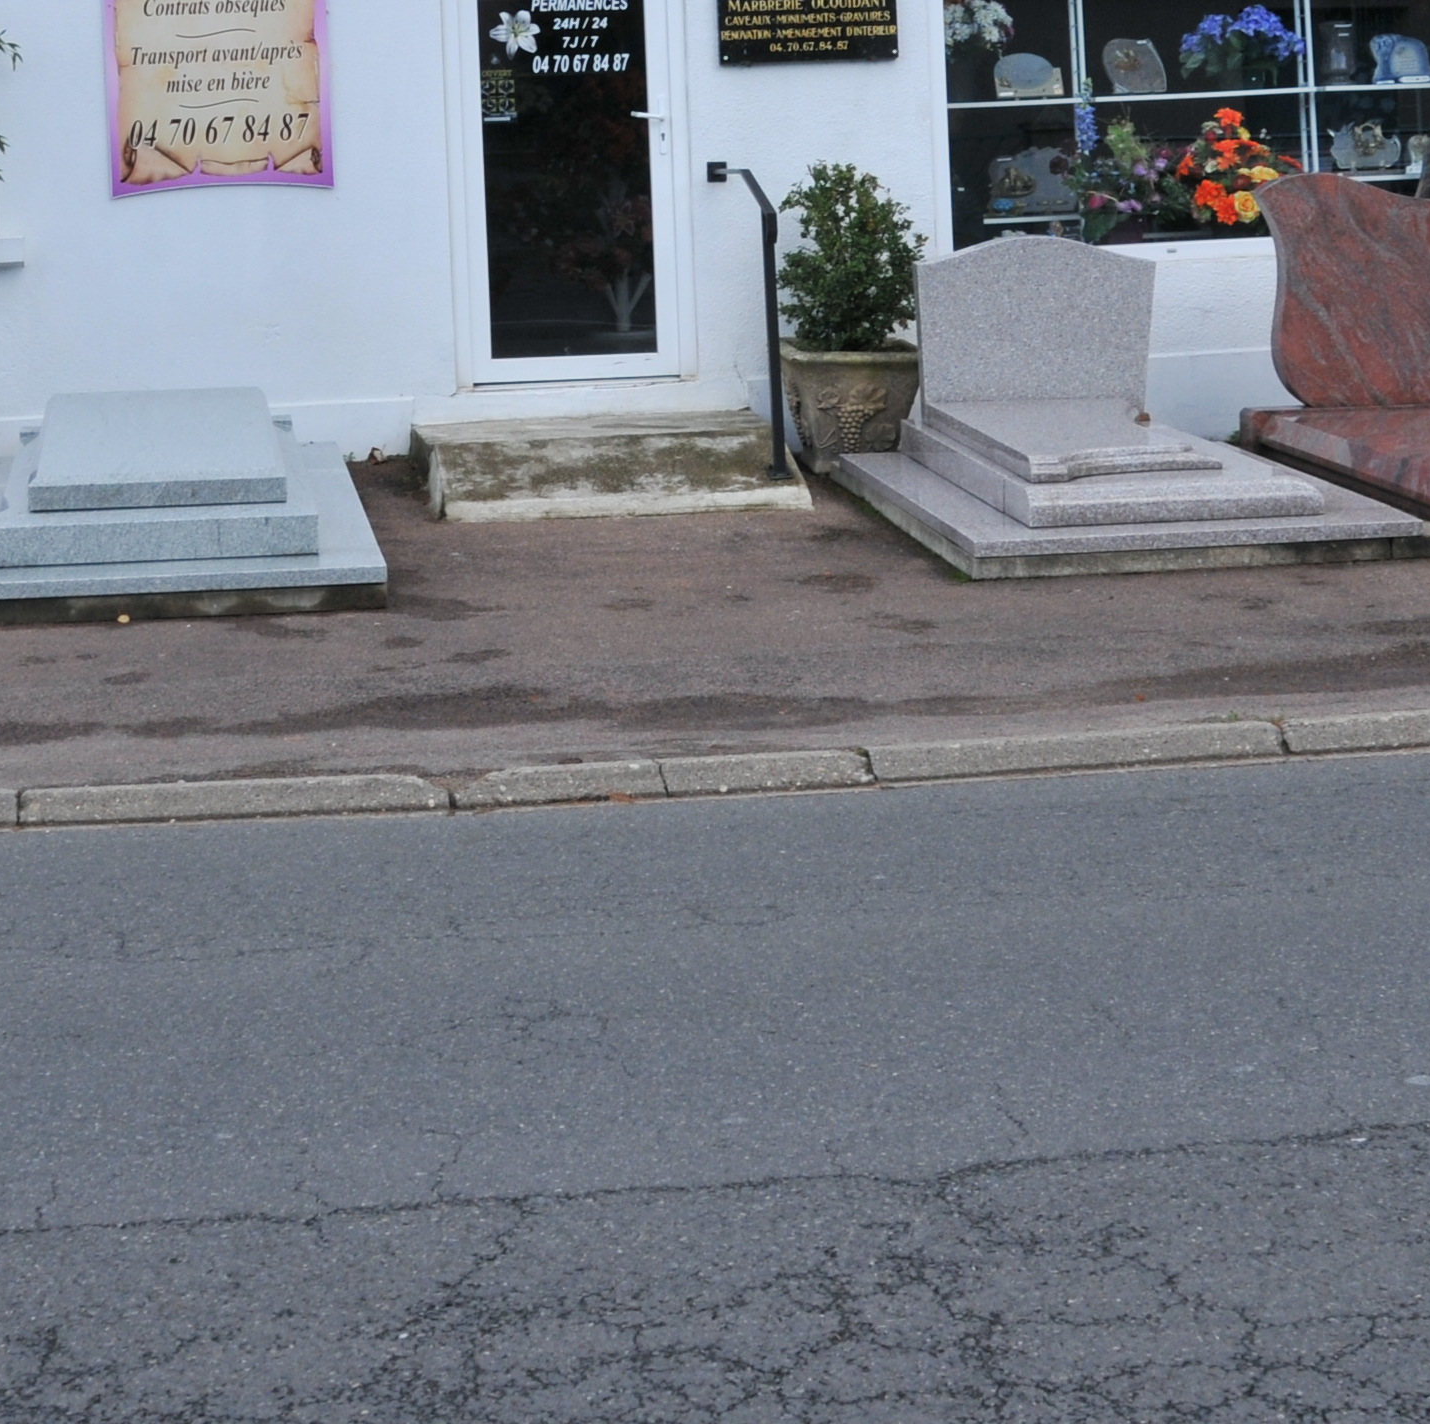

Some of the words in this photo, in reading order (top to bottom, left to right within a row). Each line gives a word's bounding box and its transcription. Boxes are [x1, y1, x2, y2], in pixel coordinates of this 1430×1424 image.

[552, 18, 580, 30] 24H
[592, 17, 608, 29] 24
[562, 36, 578, 48] 7J
[590, 36, 599, 48] 7
[131, 47, 207, 69] Transport
[211, 42, 303, 68] avant/après
[532, 55, 549, 73] 04
[553, 55, 569, 73] 70
[573, 54, 589, 72] 67
[593, 54, 609, 72] 84
[613, 53, 630, 71] 87
[166, 74, 203, 93] mise
[207, 77, 225, 92] en
[230, 72, 270, 90] bière
[129, 119, 158, 150] 04
[168, 117, 197, 147] 70
[204, 116, 234, 145] 67
[242, 114, 270, 143] 84
[280, 112, 310, 142] 87
